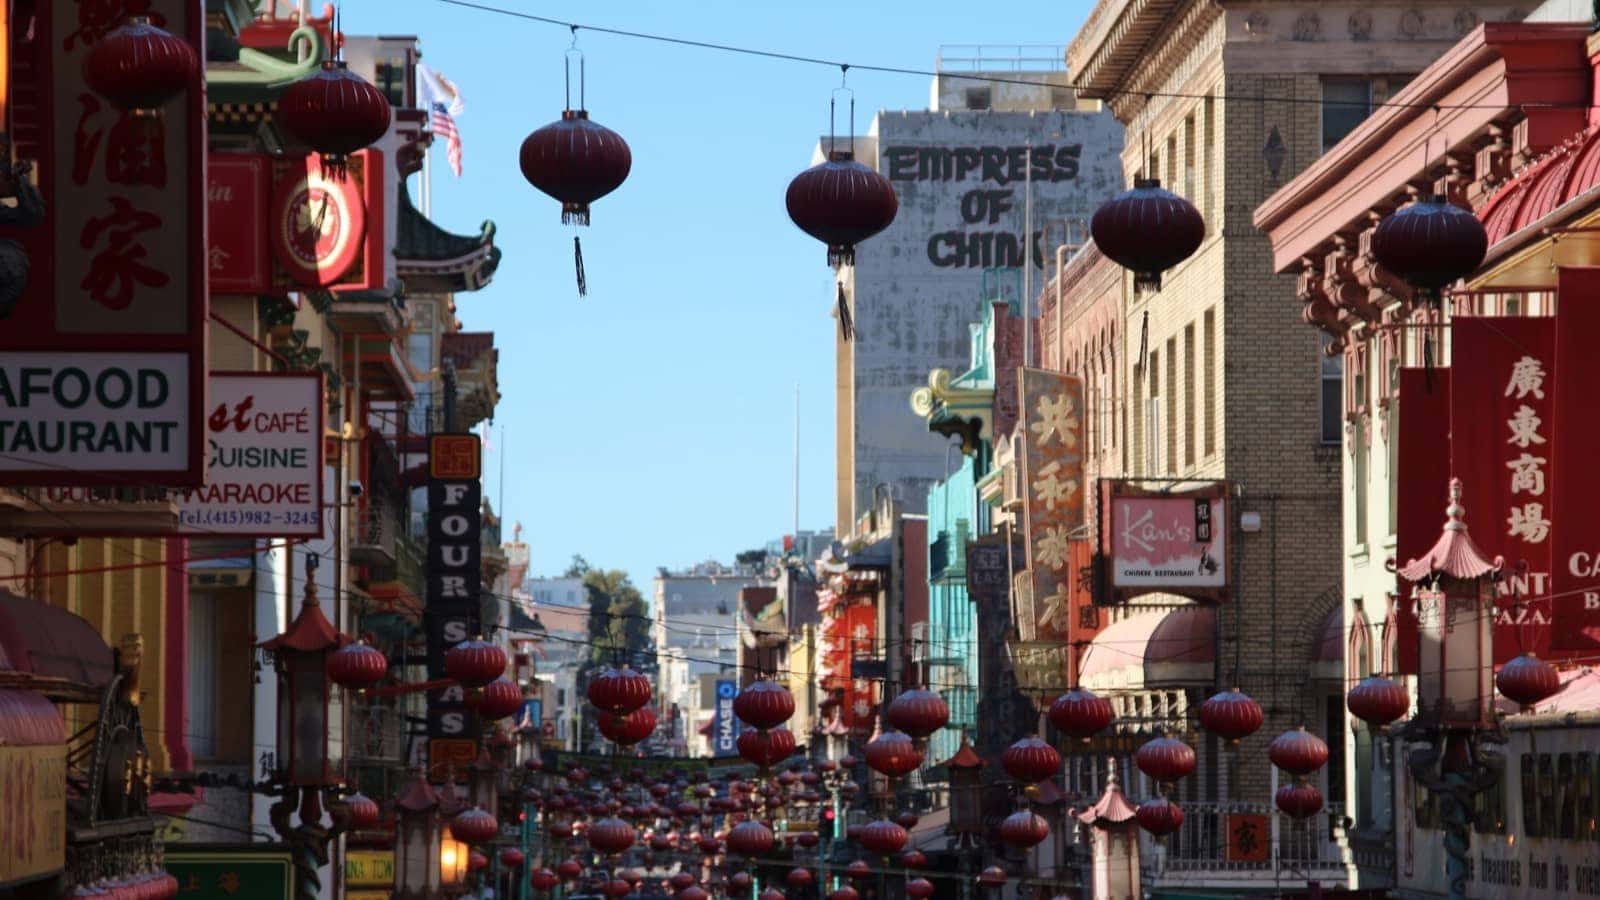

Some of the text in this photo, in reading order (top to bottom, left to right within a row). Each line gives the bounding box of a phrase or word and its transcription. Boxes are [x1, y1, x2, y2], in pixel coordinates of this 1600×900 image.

[63, 0, 169, 309] 酒家
[883, 143, 1083, 185] EMPRESS
[960, 188, 1015, 225] OF
[927, 230, 1045, 270] CHINA
[0, 421, 178, 453] TAURANT
[254, 408, 309, 433] CAFÉ
[1504, 356, 1552, 543] 廣東商場
[440, 483, 470, 598] FOUR
[1122, 504, 1192, 552] Kan's
[1495, 572, 1552, 596] ANT
[1494, 608, 1552, 625] AZA
[439, 621, 467, 735] SAS
[719, 698, 734, 750] CHASE
